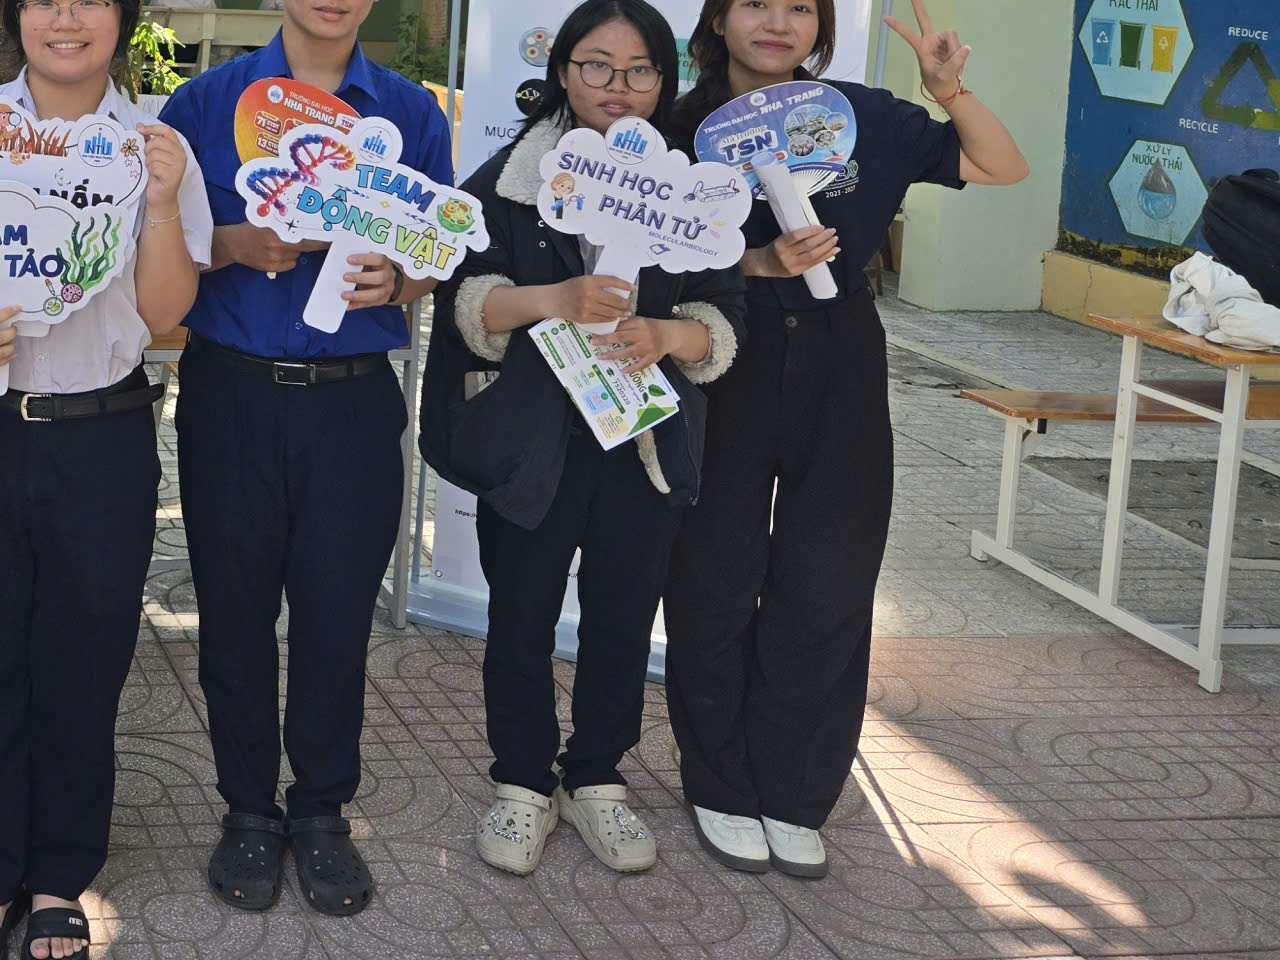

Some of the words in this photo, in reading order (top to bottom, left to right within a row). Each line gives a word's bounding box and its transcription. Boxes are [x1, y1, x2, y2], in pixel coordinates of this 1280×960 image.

[1228, 26, 1269, 41] REDUCE
[283, 98, 303, 113] NHA
[305, 105, 335, 125] TRANG
[760, 100, 783, 115] NHA
[786, 87, 824, 105] TRANG
[484, 125, 517, 140] MỤC
[1178, 118, 1220, 134] RECYCLE
[721, 131, 774, 162] TSN
[355, 164, 437, 213] TEAM
[557, 151, 617, 184] SINH
[619, 171, 674, 201] HỌC
[825, 189, 841, 198] 2023
[296, 186, 392, 244] ĐỘNG
[395, 224, 457, 270] VẬT
[598, 194, 666, 230] PHÂN
[671, 215, 708, 241] TỬ
[4, 248, 65, 278] TẢO
